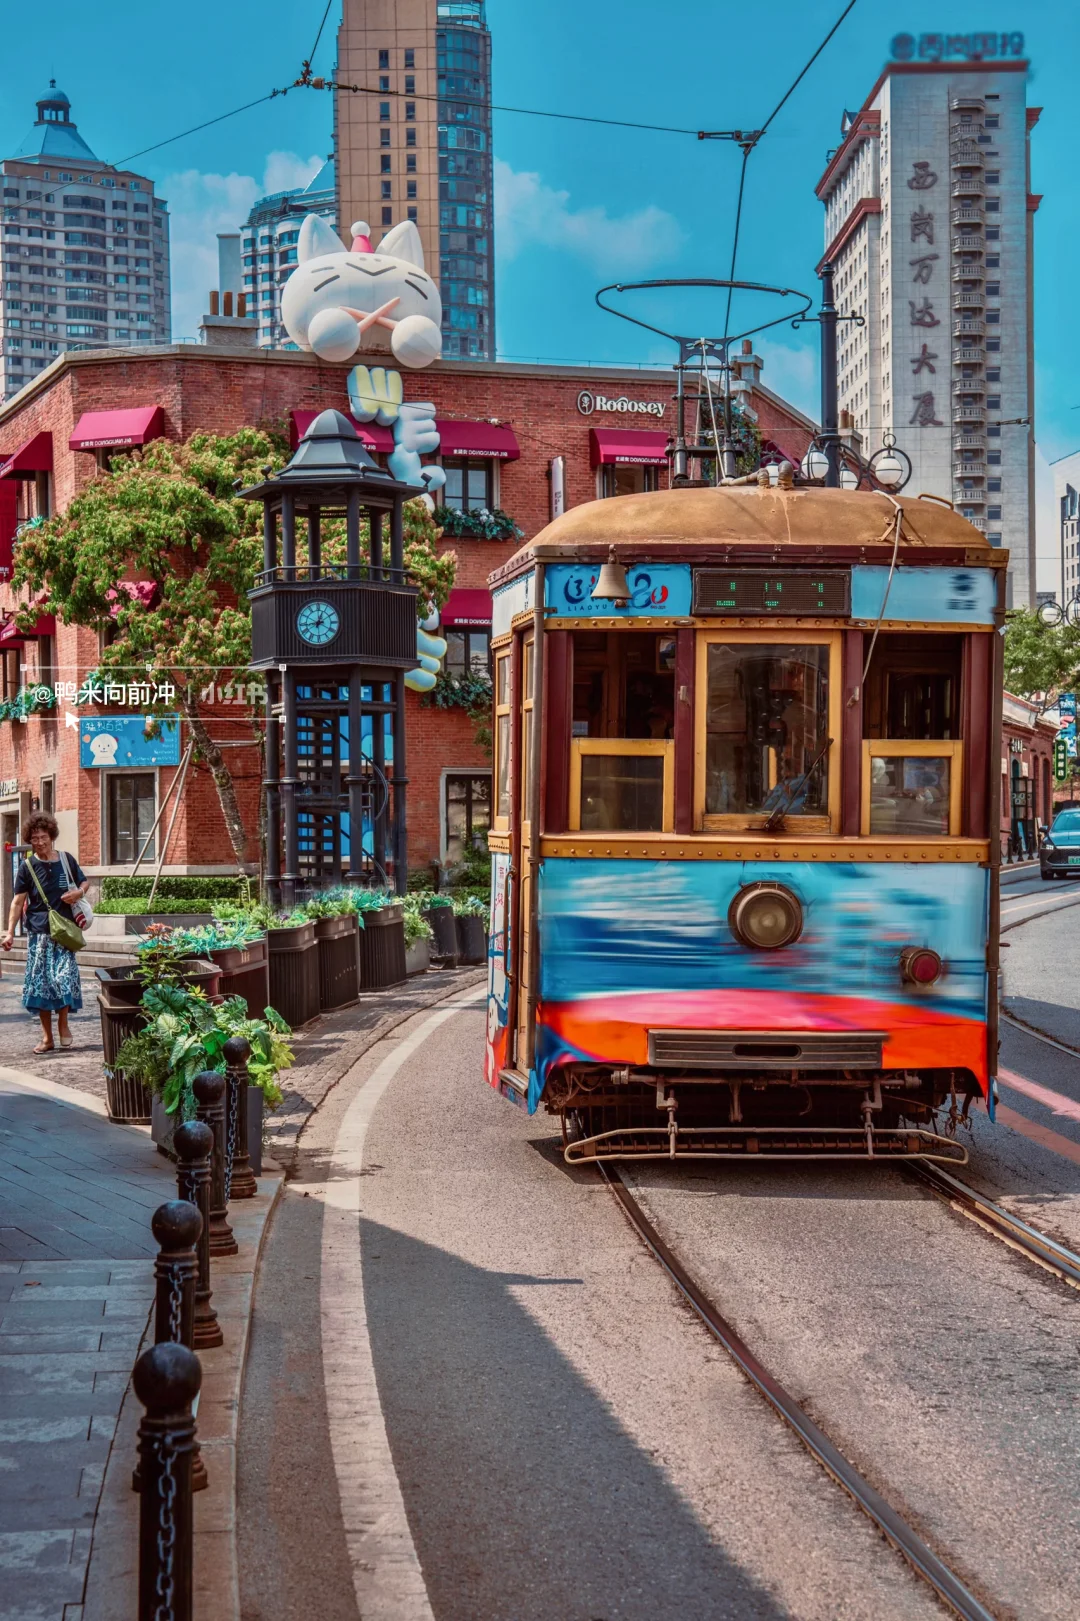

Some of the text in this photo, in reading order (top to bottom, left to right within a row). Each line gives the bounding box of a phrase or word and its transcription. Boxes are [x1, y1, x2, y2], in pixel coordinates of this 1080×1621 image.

[907, 161, 943, 426] 西岗万达大厦
